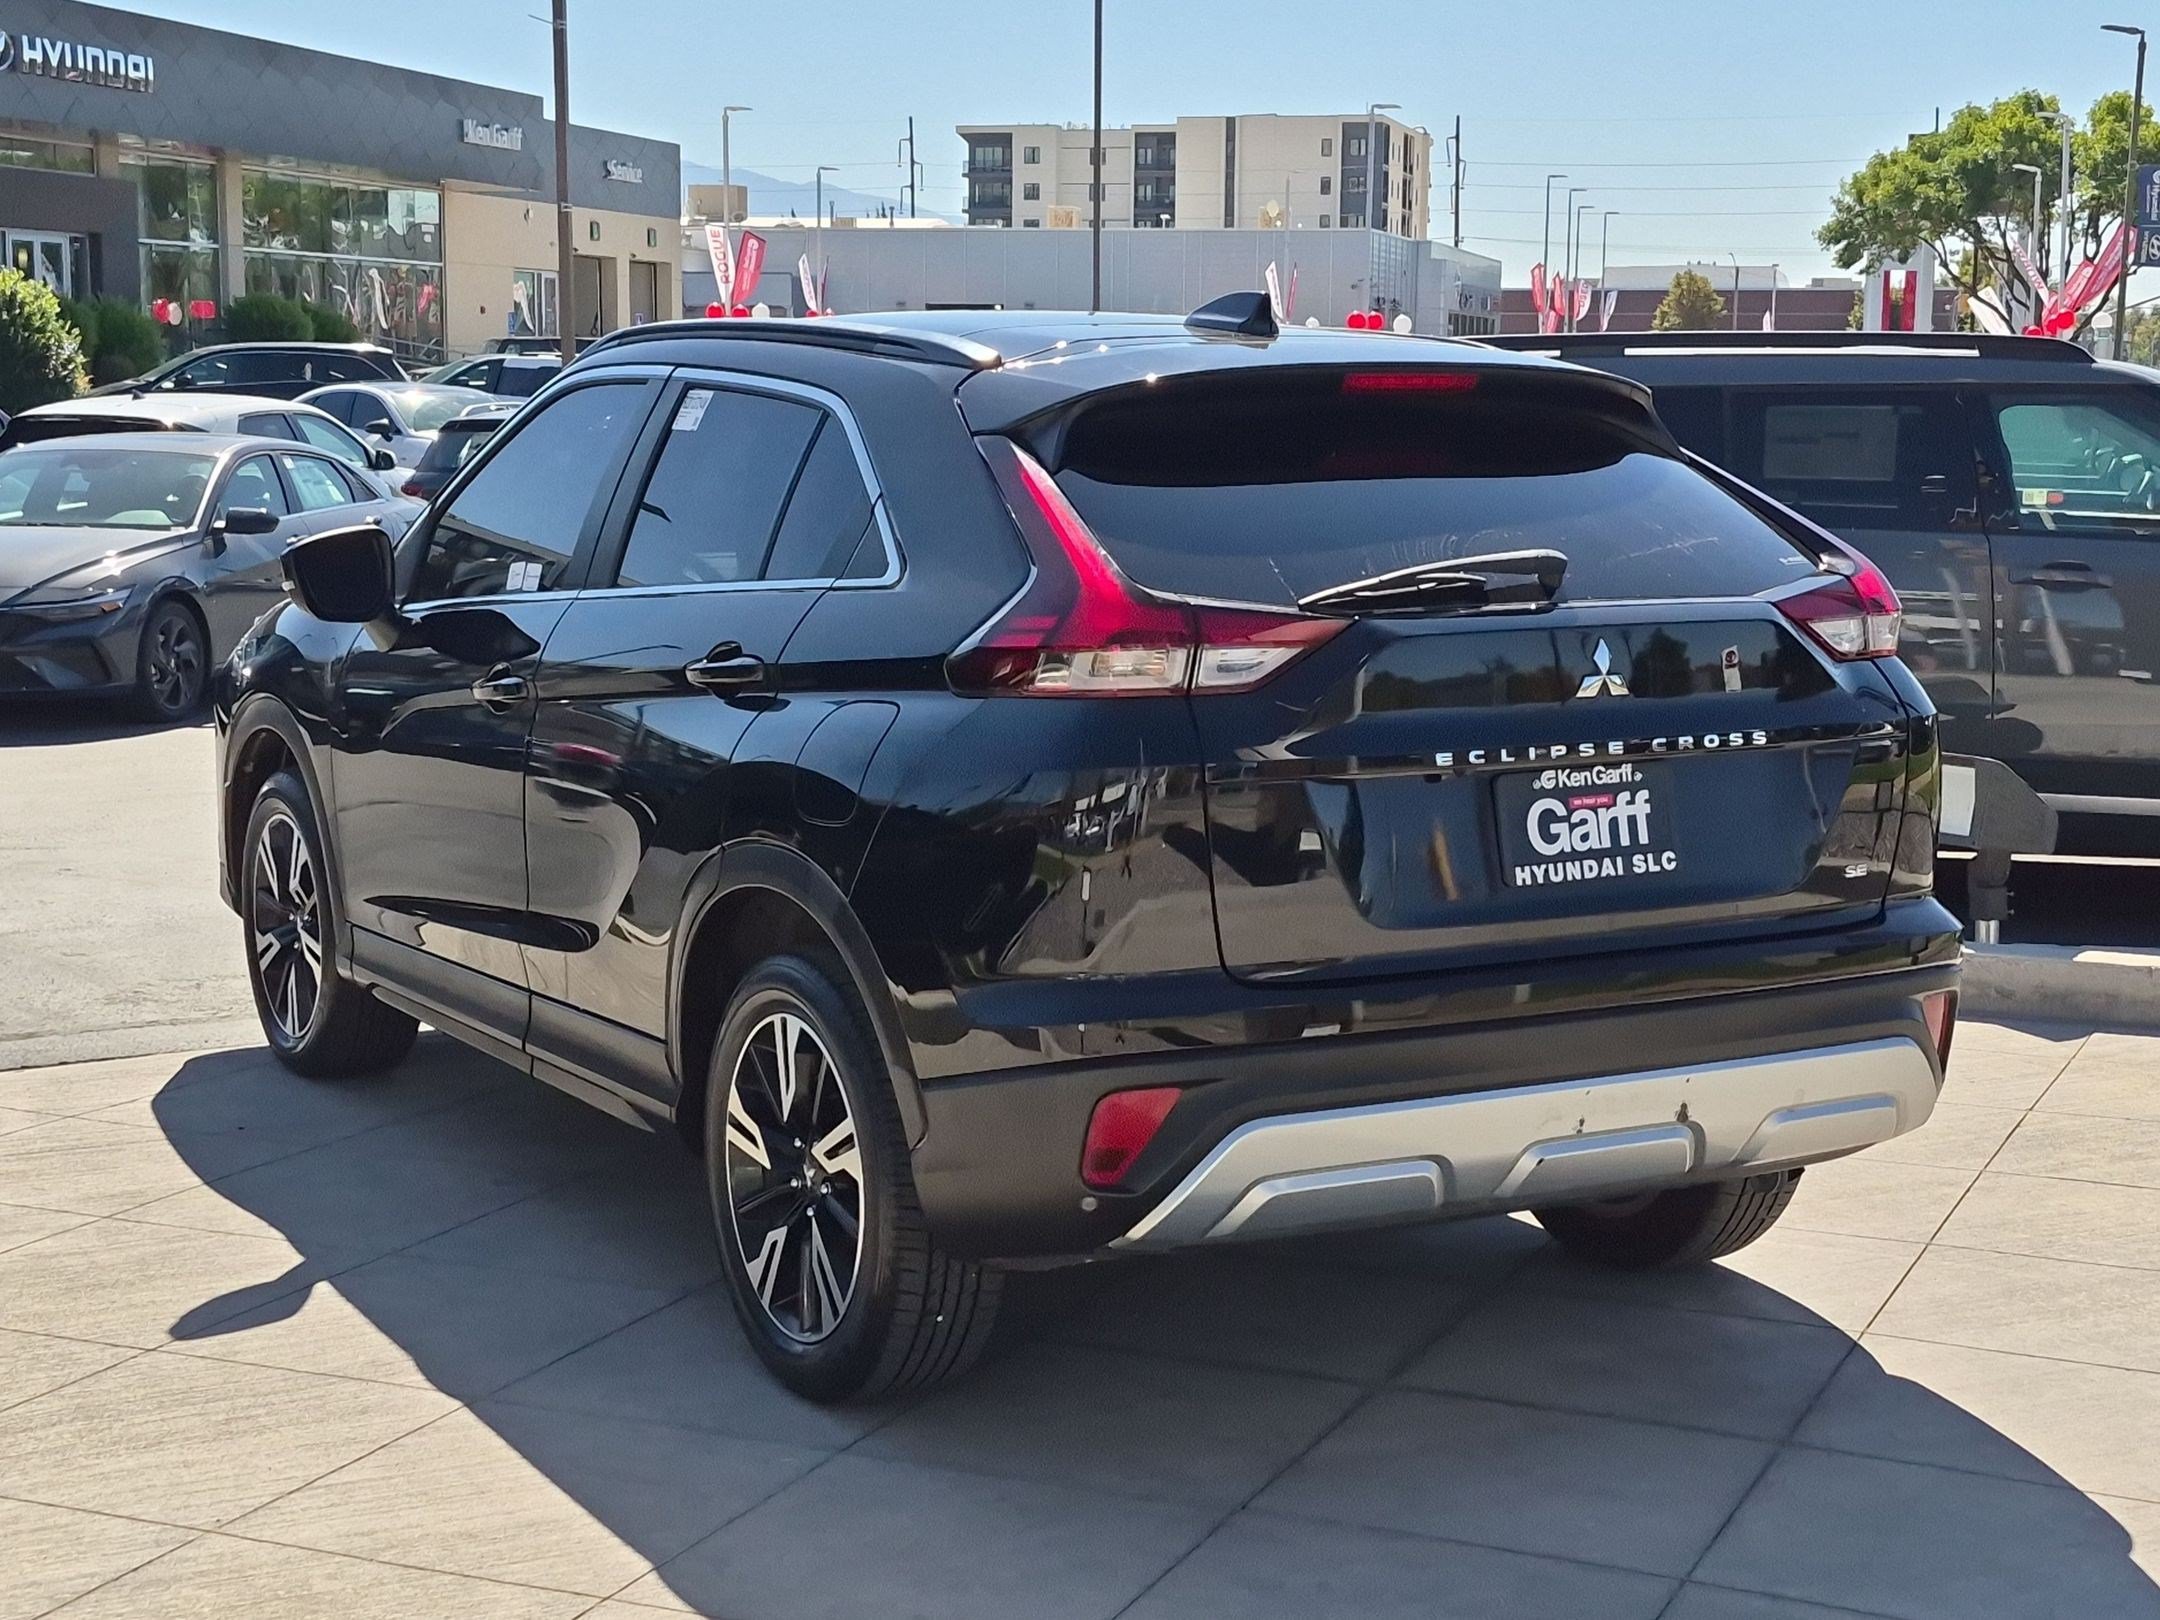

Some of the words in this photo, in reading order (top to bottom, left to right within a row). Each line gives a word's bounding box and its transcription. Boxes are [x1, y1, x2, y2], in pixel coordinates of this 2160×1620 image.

[22, 34, 154, 93] HYUNDAI
[463, 119, 490, 145] Ken
[492, 124, 523, 150] Garff
[607, 160, 643, 183] Service
[710, 229, 732, 285] ROGUE
[1435, 740, 1625, 767] ECLIPSE
[1651, 730, 1768, 752] CROSS
[1526, 789, 1651, 856] Garff
[1515, 856, 1624, 886] HYUNDAI
[1632, 850, 1677, 874] SLC
[1844, 863, 1868, 878] SE
